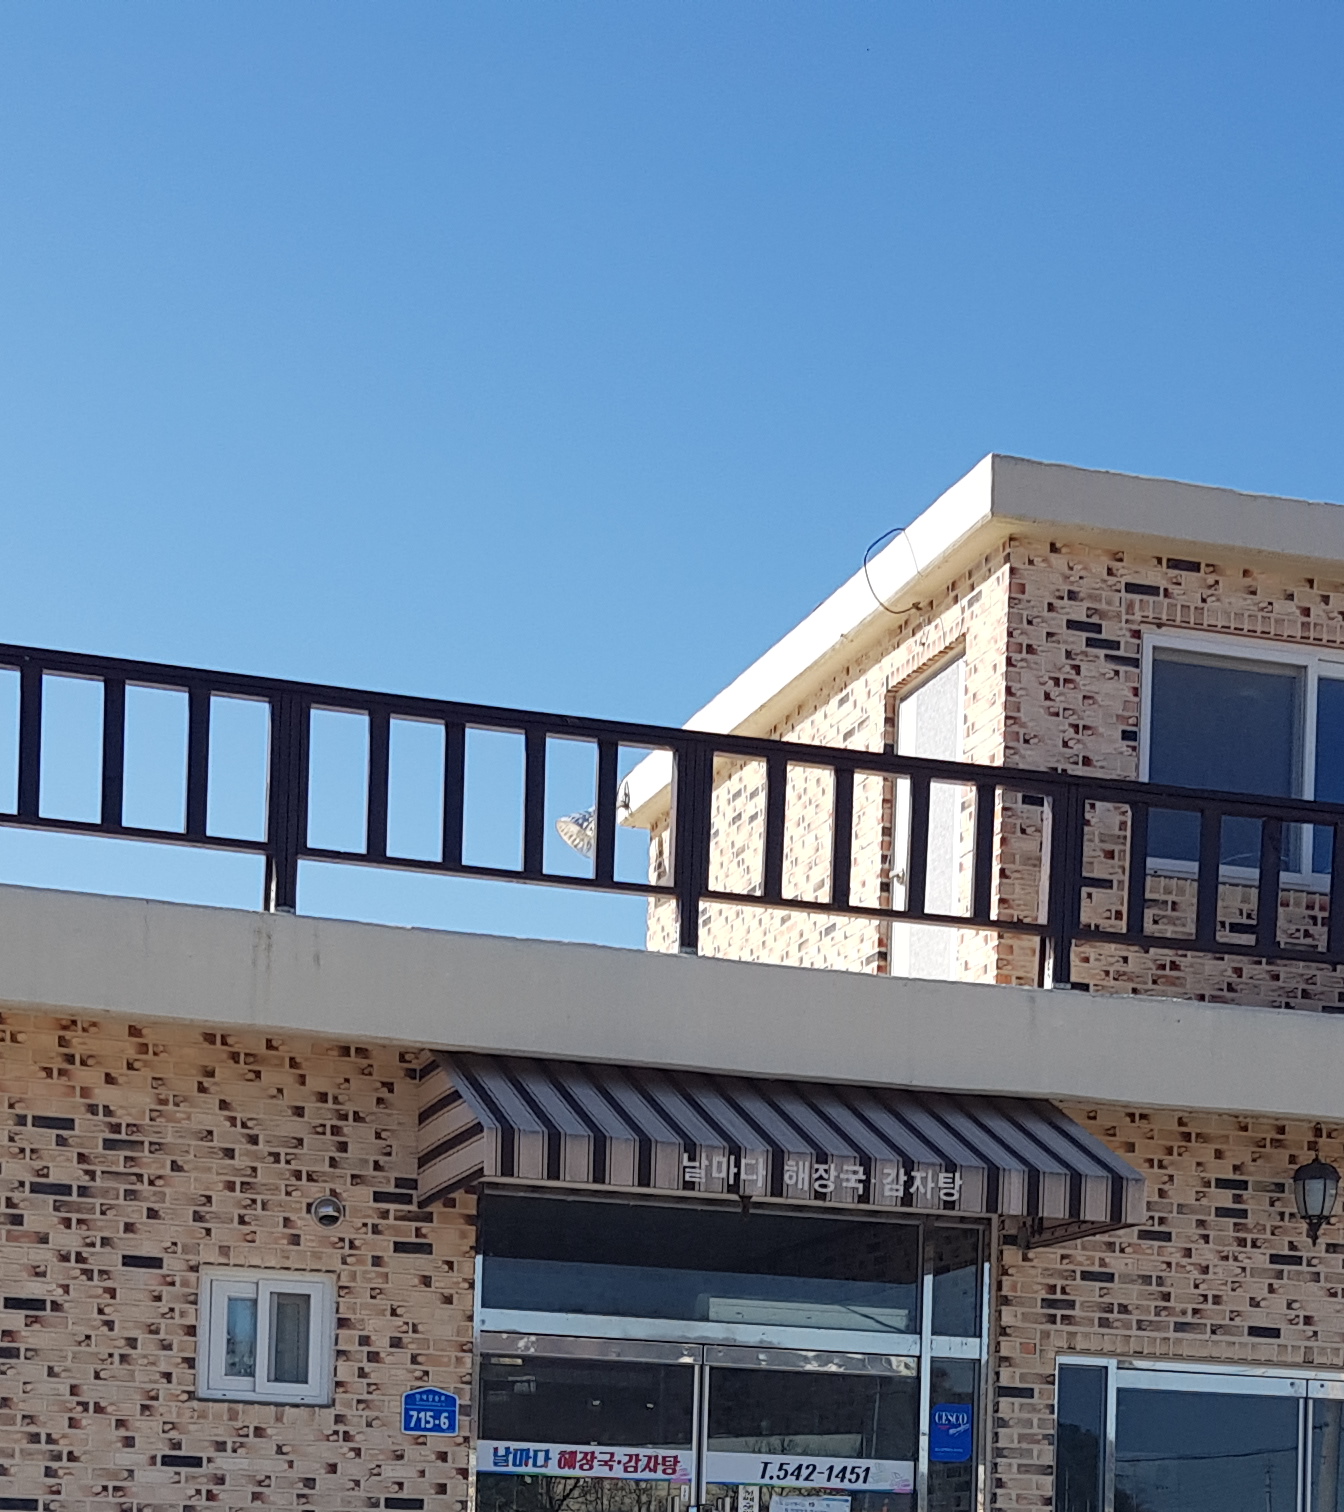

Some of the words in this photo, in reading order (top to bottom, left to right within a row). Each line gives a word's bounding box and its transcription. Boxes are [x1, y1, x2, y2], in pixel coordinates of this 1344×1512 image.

[683, 1152, 767, 1188] 날마다
[408, 1410, 449, 1430] 715-6
[935, 1411, 968, 1425] CESCO
[492, 1446, 552, 1469] 날마다
[760, 1461, 871, 1485] T.542-1451
